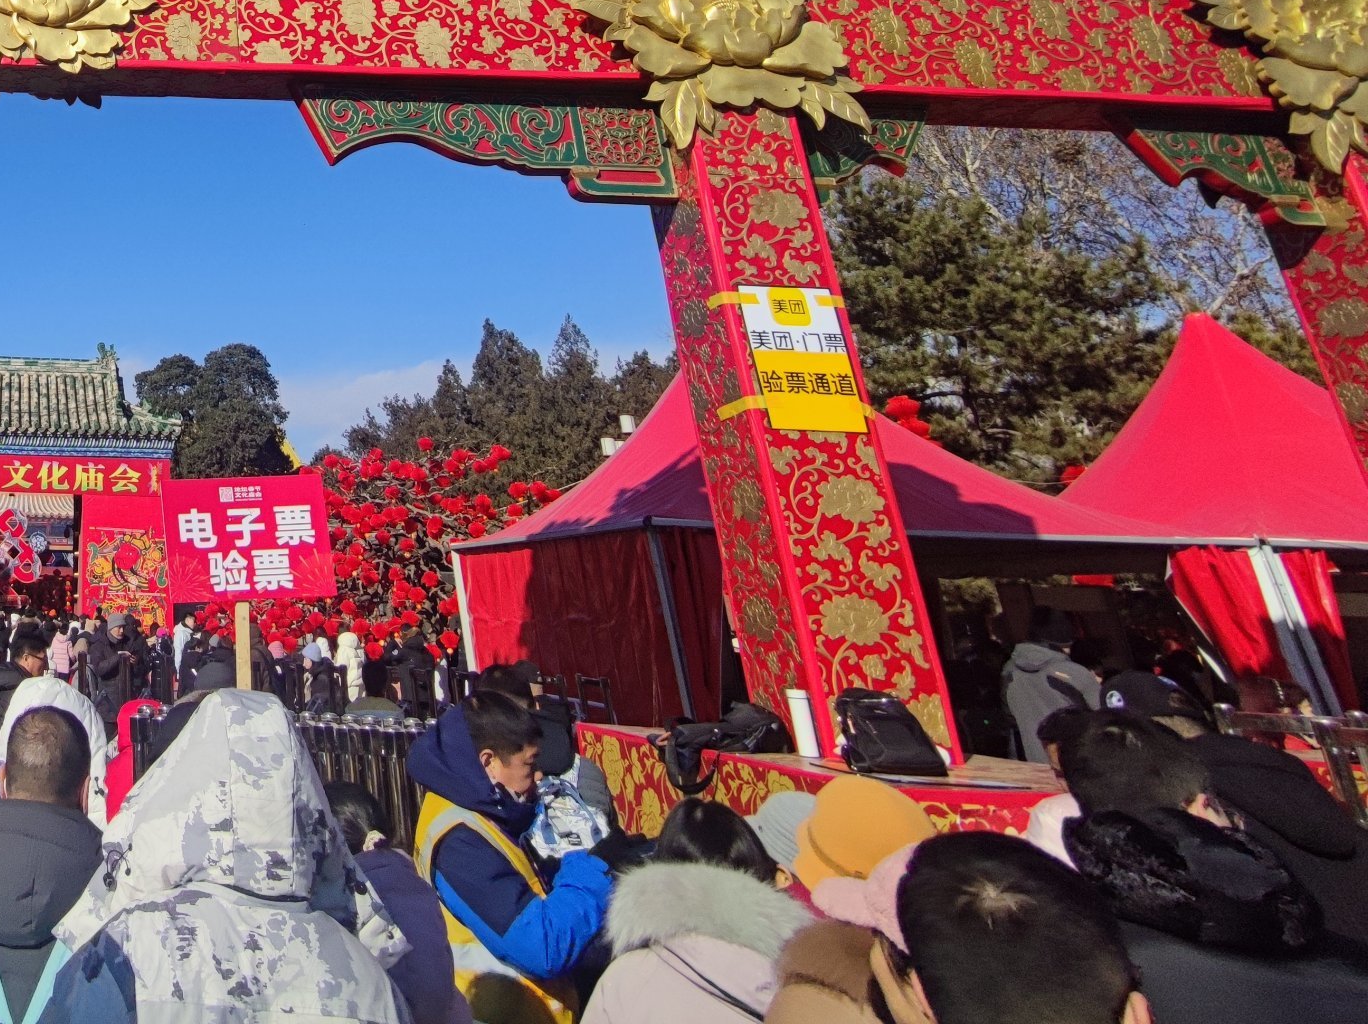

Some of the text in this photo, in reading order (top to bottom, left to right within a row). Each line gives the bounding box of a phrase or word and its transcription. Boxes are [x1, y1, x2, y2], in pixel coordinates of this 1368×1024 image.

[771, 299, 806, 315] 美团
[760, 370, 857, 396] 验票通道
[177, 504, 316, 549] 电子票
[207, 548, 295, 593] 验票
